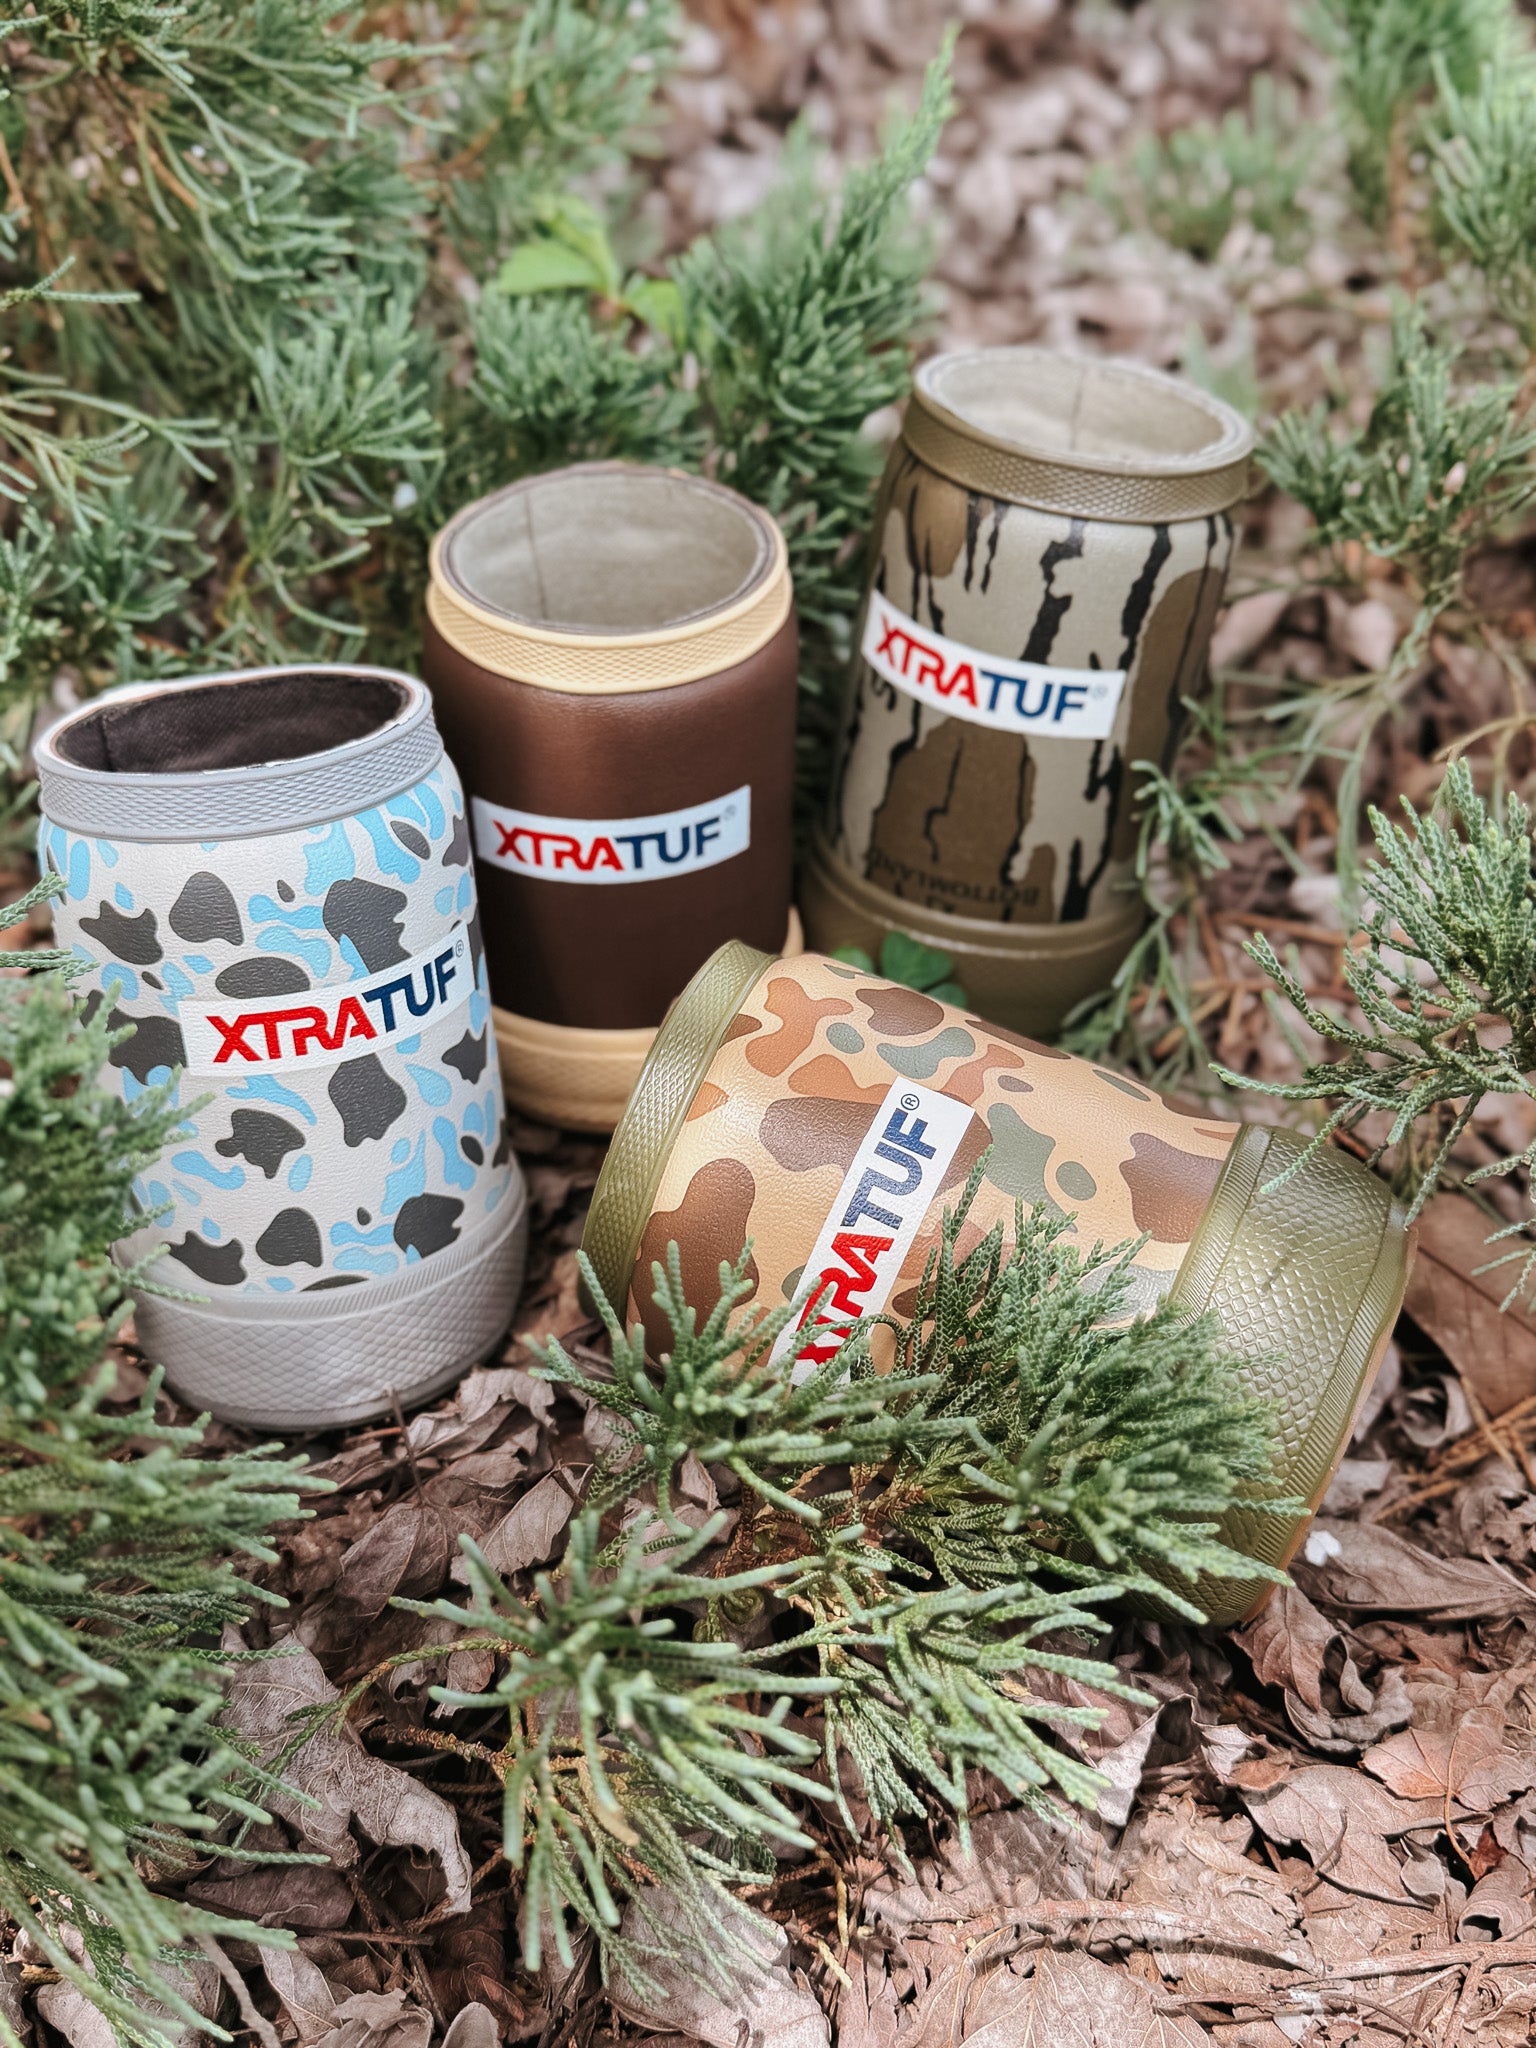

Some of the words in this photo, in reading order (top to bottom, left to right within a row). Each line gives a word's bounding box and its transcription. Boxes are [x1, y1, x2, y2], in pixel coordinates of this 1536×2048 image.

[876, 613, 1088, 723] XTRATUF
[492, 815, 720, 872] XTRATUF
[205, 945, 457, 1064] XTRATUF
